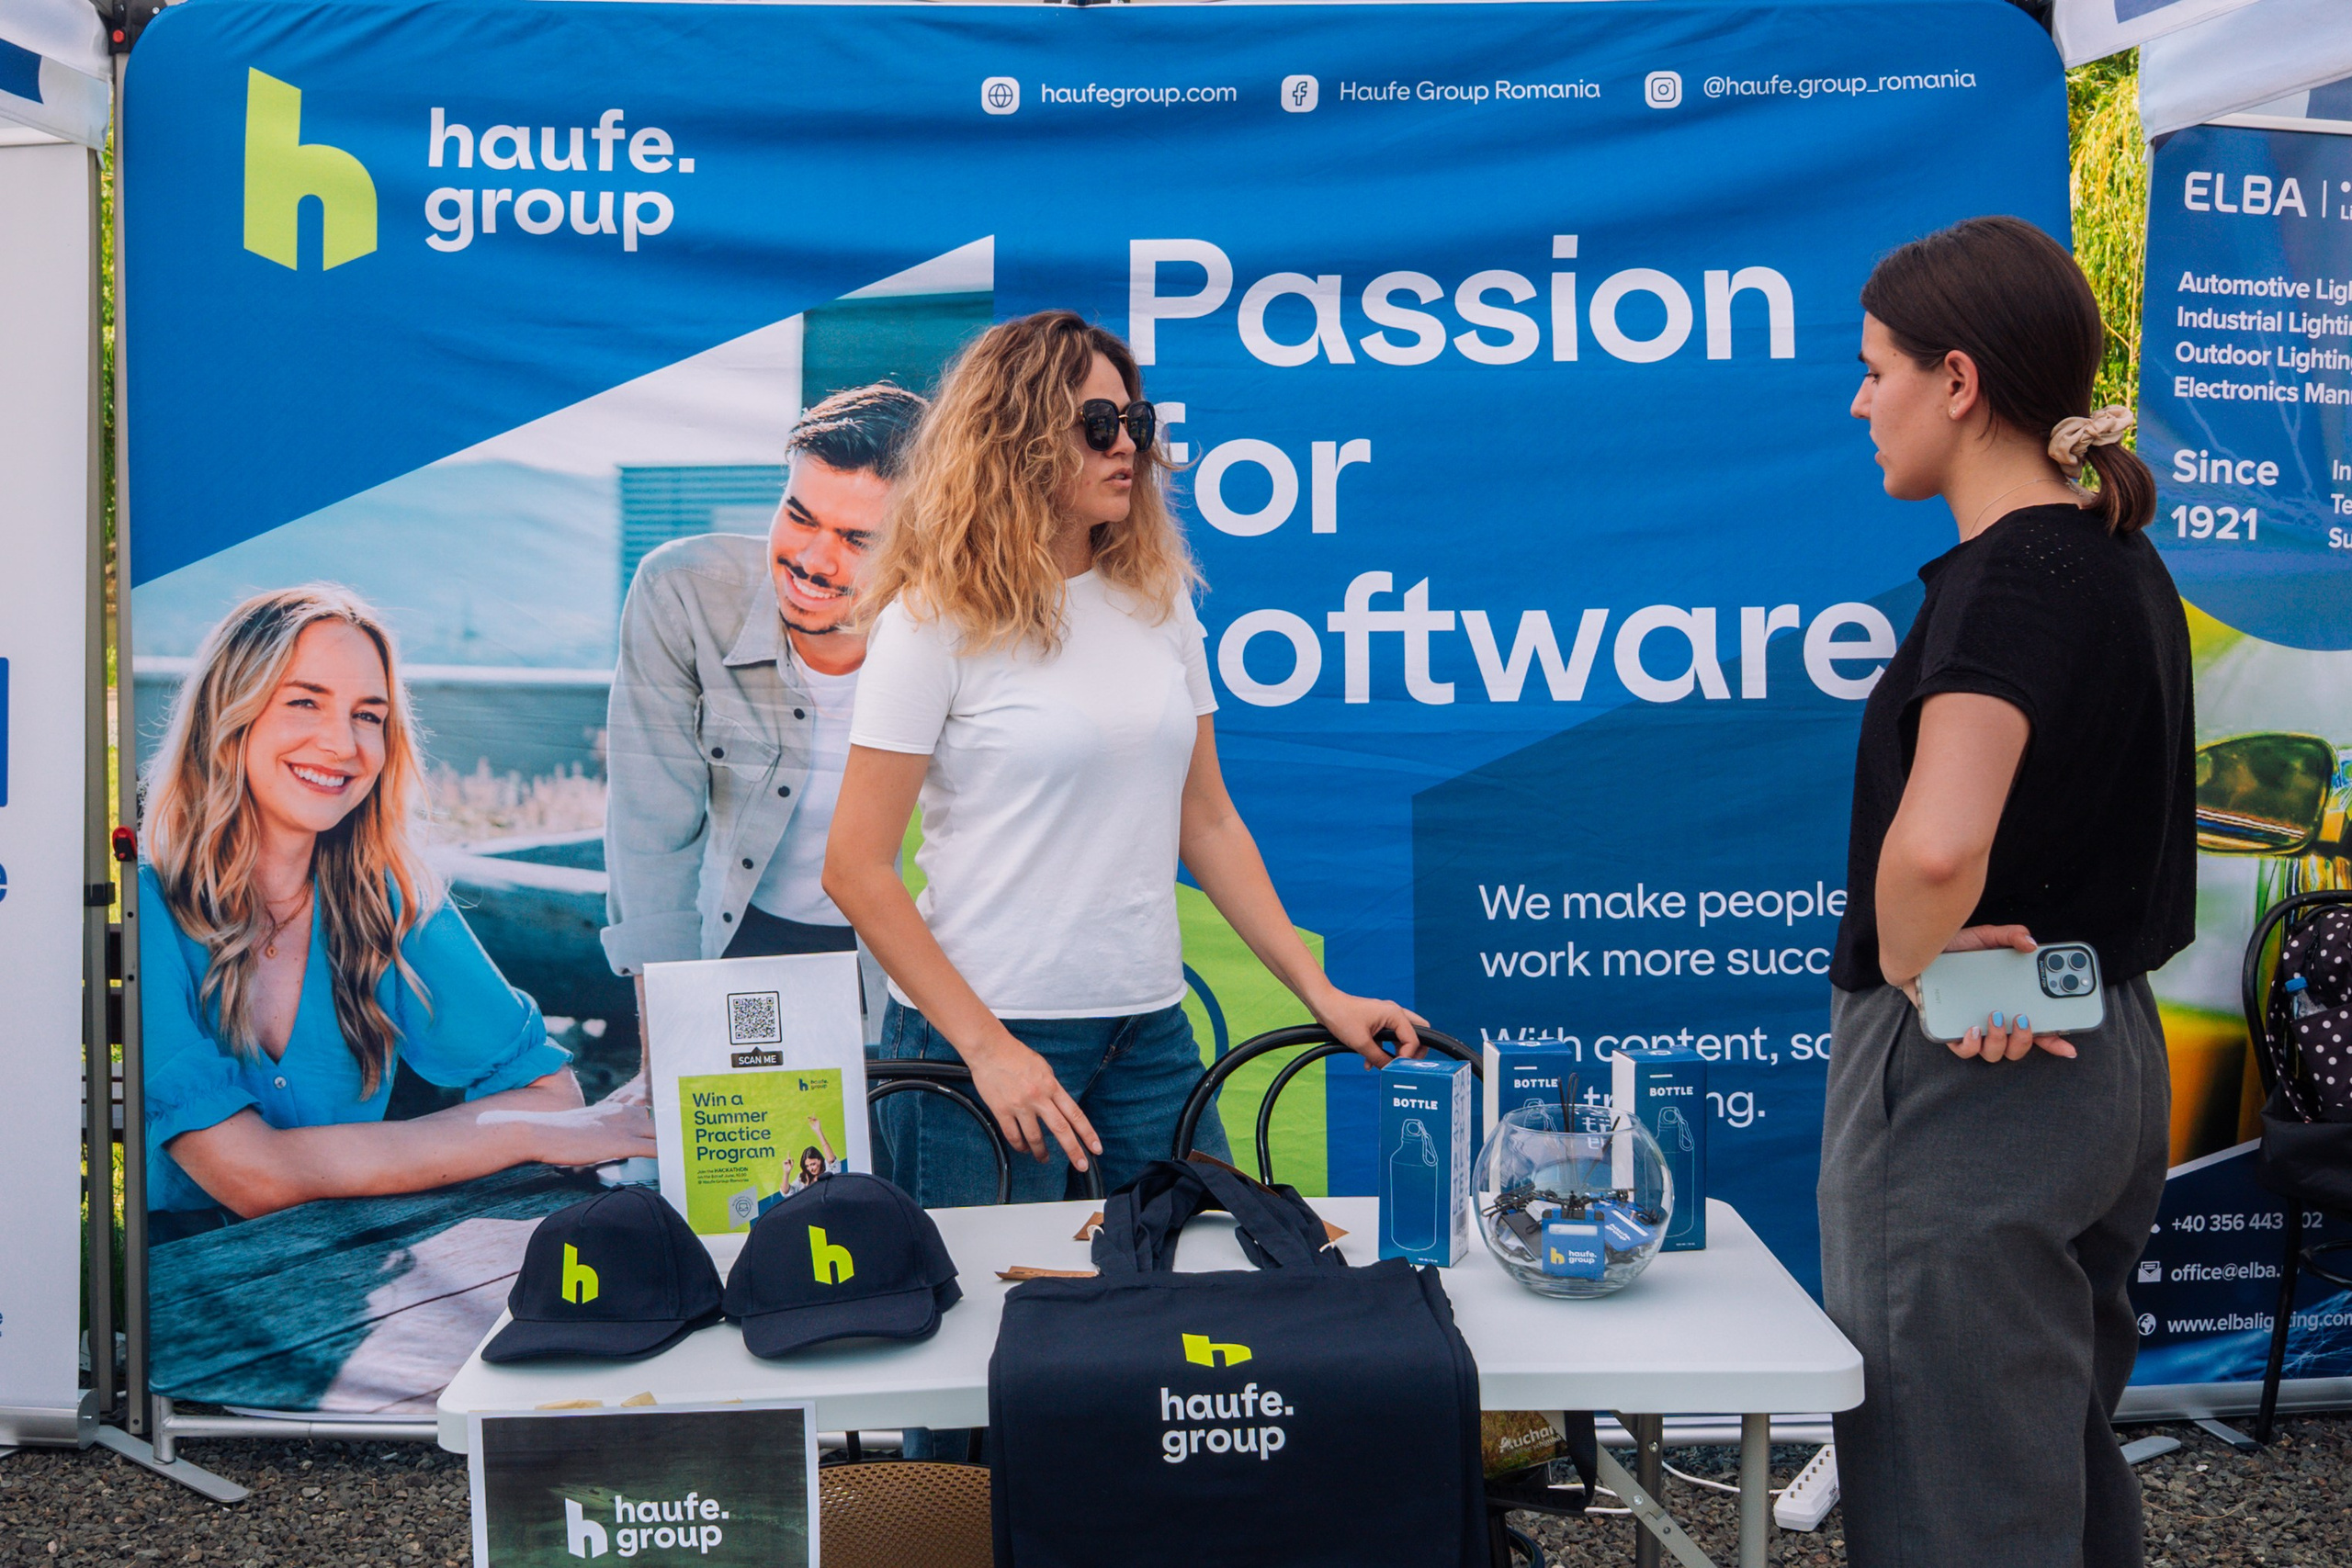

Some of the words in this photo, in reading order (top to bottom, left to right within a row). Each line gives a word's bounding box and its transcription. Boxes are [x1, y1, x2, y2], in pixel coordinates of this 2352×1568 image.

[1041, 82, 1238, 108] haufegroup.com
[1340, 80, 1411, 102] Haufe
[1416, 80, 1490, 107] Group
[1495, 78, 1601, 101] Romania
[1703, 69, 1977, 99] @haufe.group_romania
[428, 107, 696, 174] haufe.
[2184, 171, 2308, 218] ELBA
[424, 186, 674, 254] group
[2177, 271, 2311, 299] Automotive
[1128, 234, 1796, 367] Passion
[2177, 305, 2283, 333] Industrial
[2175, 341, 2272, 367] Outdoor
[2277, 345, 2352, 374] Lightin
[2174, 376, 2300, 403] Electronics
[2304, 382, 2352, 405] Man
[2172, 448, 2279, 487] Since
[2170, 504, 2258, 541] 1921
[1198, 570, 1898, 707] oftware
[1478, 884, 1551, 920] We
[1563, 882, 1687, 919] make
[1699, 880, 1848, 928] people
[1479, 941, 1591, 978] work
[1603, 948, 1715, 976] more
[738, 1055, 763, 1066] SCAN
[763, 1055, 777, 1064] ME
[1594, 1026, 1778, 1066] content,
[1513, 1077, 1559, 1089] BOTTLE
[1649, 1086, 1694, 1098] BOTTLE
[692, 1091, 727, 1108] Win
[730, 1094, 744, 1106] a
[1393, 1097, 1439, 1111] BOTTLE
[694, 1111, 768, 1126] Summer
[695, 1126, 772, 1144] Practice
[696, 1145, 775, 1164] Program
[2171, 1214, 2206, 1233] +40
[2209, 1213, 2245, 1232] 356
[2248, 1212, 2284, 1231] 443
[2301, 1211, 2324, 1229] 02
[1568, 1256, 1596, 1264] group
[2170, 1261, 2301, 1282] office@elba.
[2166, 1310, 2352, 1333] www.elbaliging.co
[1160, 1382, 1295, 1422] haufe.
[1161, 1426, 1285, 1464] group
[615, 1491, 729, 1523] haufe.
[616, 1525, 723, 1557] group
